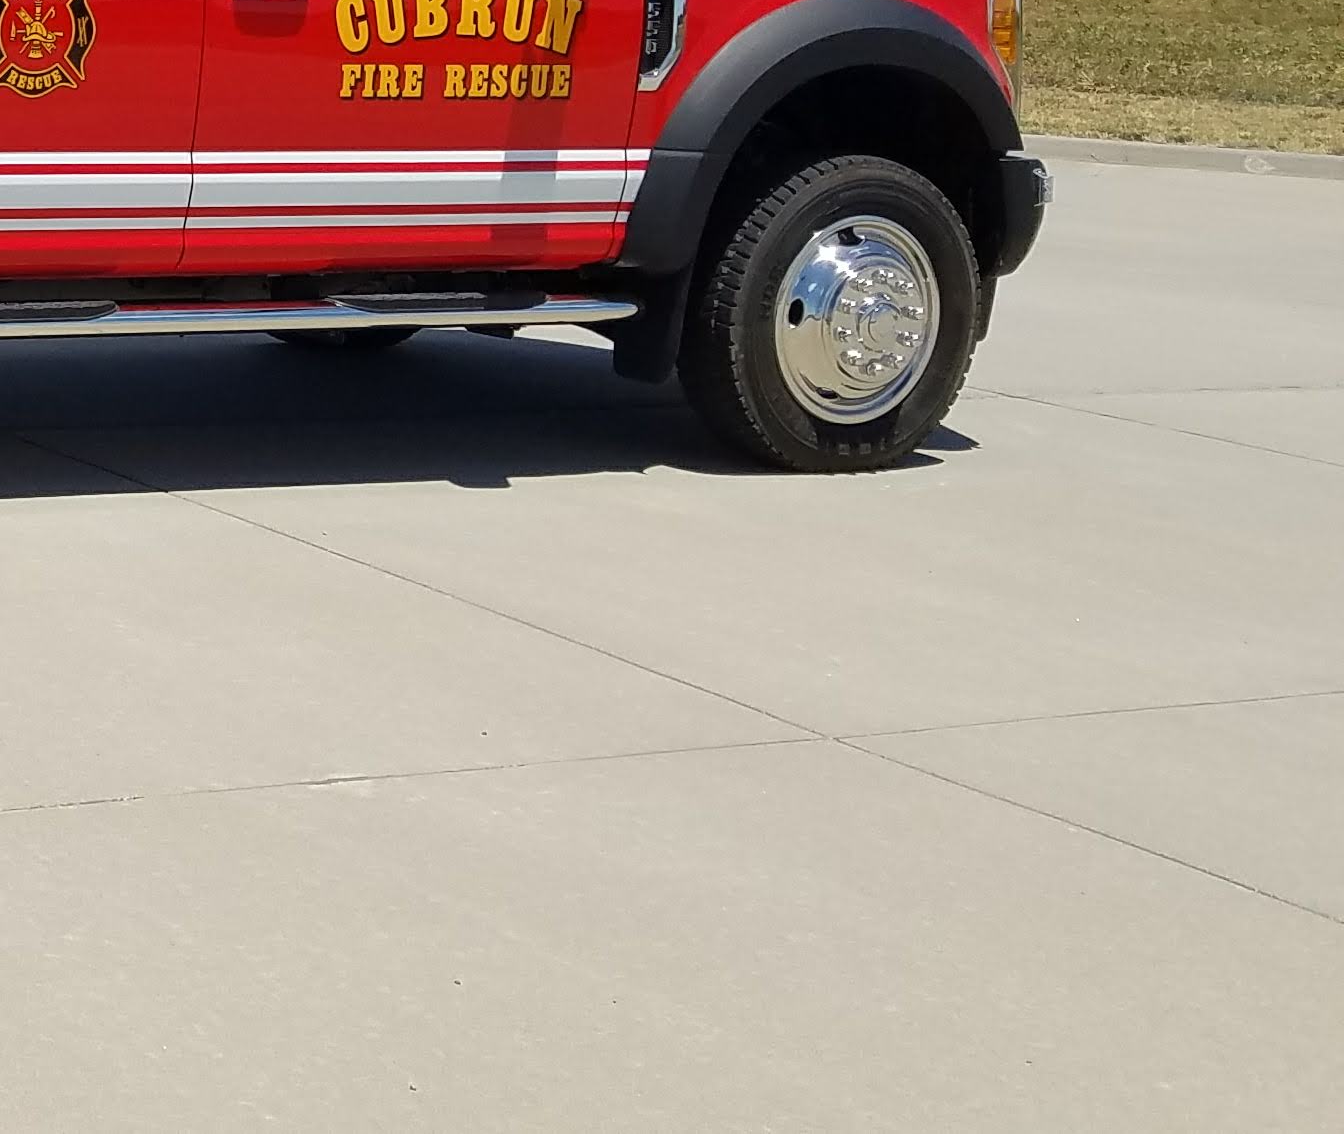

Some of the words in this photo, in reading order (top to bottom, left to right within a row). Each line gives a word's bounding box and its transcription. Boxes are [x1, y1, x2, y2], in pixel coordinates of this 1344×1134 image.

[6, 69, 63, 90] RESCUE
[339, 63, 424, 99] FIRE
[443, 63, 571, 99] RESCUE
